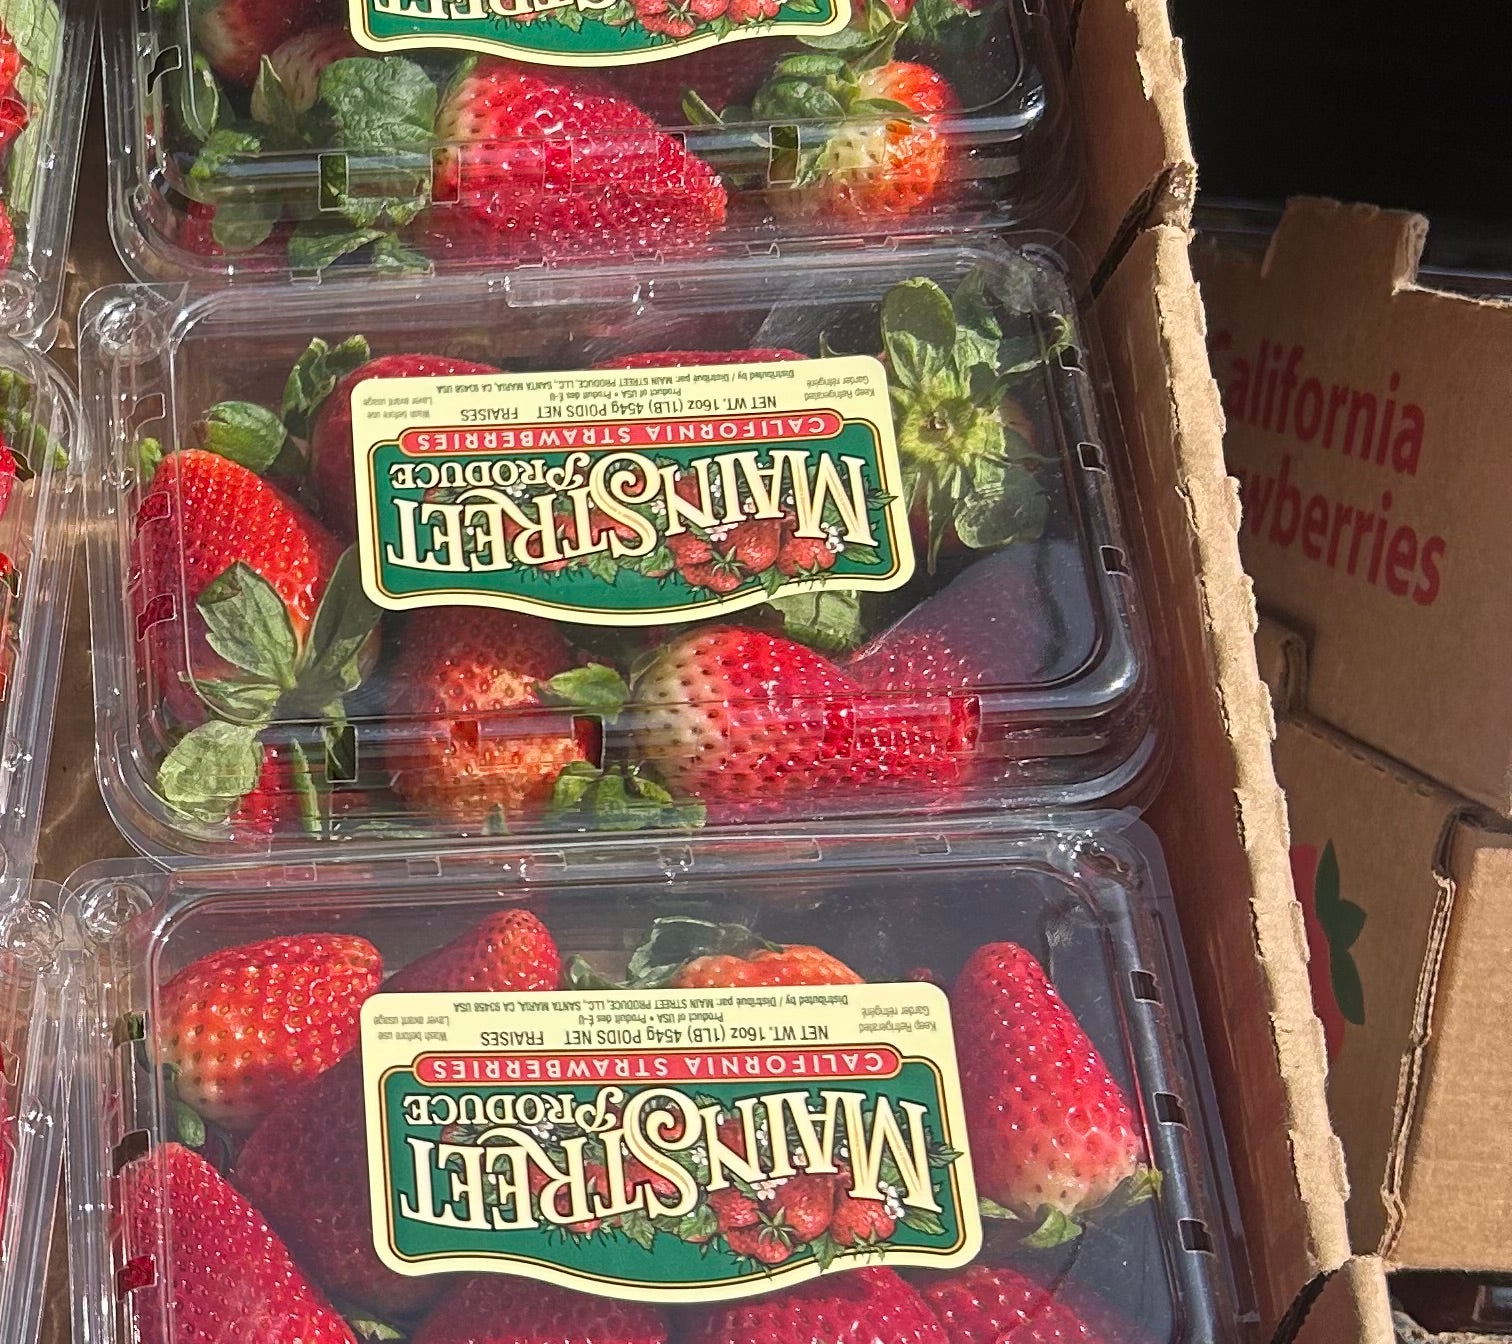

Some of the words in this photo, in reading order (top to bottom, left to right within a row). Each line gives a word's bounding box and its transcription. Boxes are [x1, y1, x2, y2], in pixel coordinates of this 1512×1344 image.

[566, 403, 606, 417] POIDS
[612, 399, 643, 415] 454g
[648, 398, 682, 414] (1LB)
[687, 398, 719, 412] 16oz
[723, 397, 747, 410] WT.
[751, 396, 776, 409] NET
[1210, 331, 1425, 476] alifornia
[460, 407, 518, 422] FRAISES
[537, 405, 561, 419] NET
[645, 417, 825, 441] CALIFORNIA
[418, 426, 630, 451] STRAWBERRIES
[390, 452, 590, 489] PRODUCE
[1236, 456, 1446, 606] wberries
[480, 1031, 544, 1046] FRAISES
[565, 1030, 591, 1045] NET
[597, 1029, 641, 1044] POIDS
[647, 1026, 682, 1043] 454g
[687, 1025, 725, 1043] (1LB)
[730, 1026, 765, 1041] 16oz
[769, 1026, 796, 1041] WT.
[800, 1025, 828, 1040] NET
[434, 1057, 668, 1080] STRAWBERRIES
[684, 1053, 882, 1075] CALIFORNIA
[403, 1087, 623, 1132] PRODUCE
